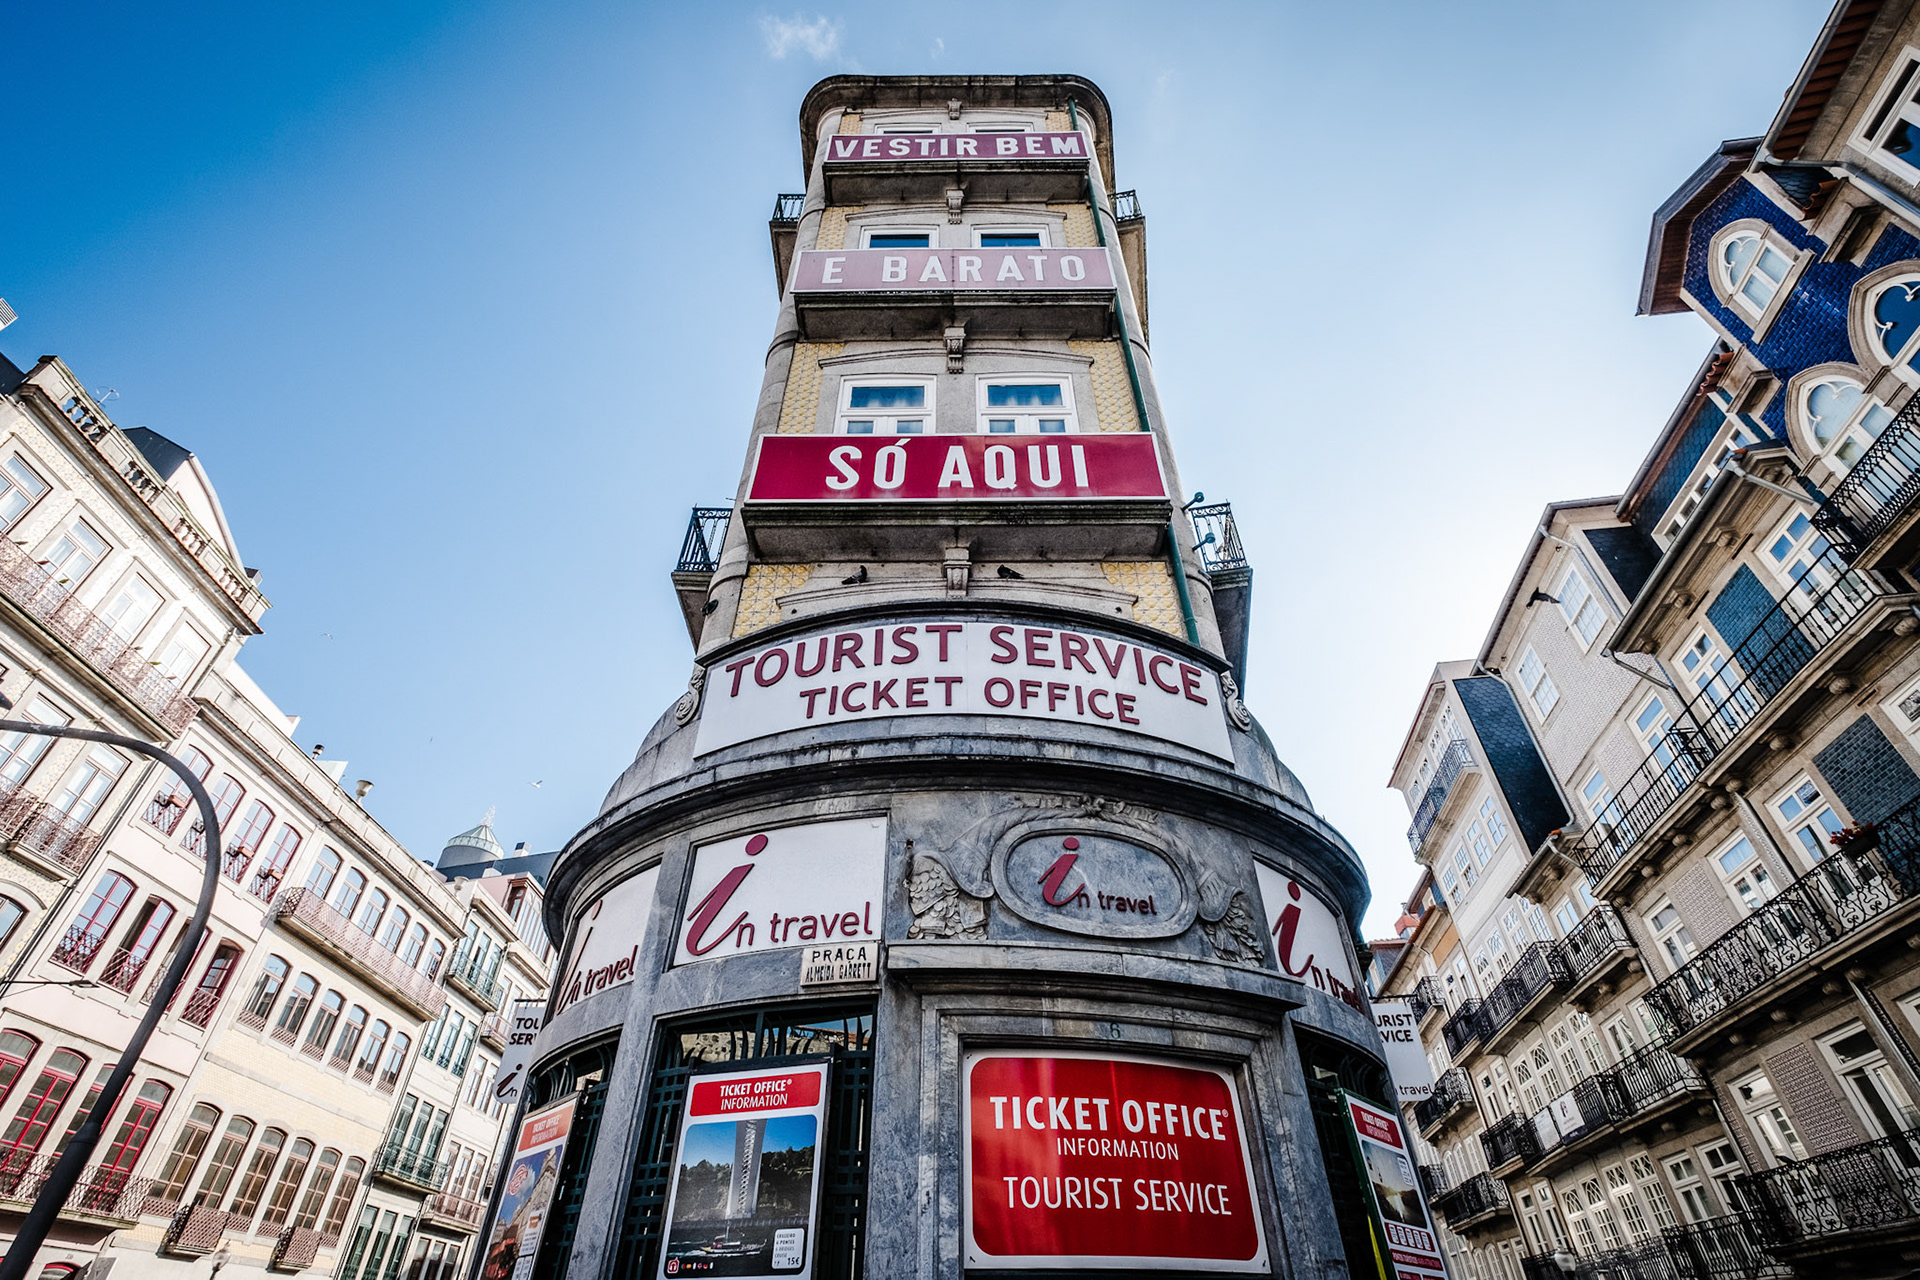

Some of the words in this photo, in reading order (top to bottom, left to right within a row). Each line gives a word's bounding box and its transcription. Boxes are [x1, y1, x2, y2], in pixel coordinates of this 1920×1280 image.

[834, 137, 978, 158] VESTIR
[997, 136, 1080, 155] BEM
[822, 257, 847, 284] E
[882, 254, 1085, 282] BARATO
[826, 439, 908, 490] SÓ
[938, 445, 1090, 490] AQUI
[726, 625, 962, 697] TOURIST
[991, 626, 1208, 705] SERVICE
[800, 676, 962, 718] TICKET
[984, 677, 1140, 724] OFFICE
[1097, 891, 1157, 915] travel
[770, 902, 873, 943] travel
[812, 946, 867, 964] PRAÇA
[583, 945, 638, 996] travel
[839, 962, 871, 980] GARRETT
[1110, 1022, 1120, 1039] 6
[720, 1083, 751, 1097] TICKET
[1399, 1083, 1433, 1096] travel
[721, 1093, 788, 1111] INFORMATION
[990, 1096, 1109, 1131] TICKET
[1057, 1137, 1179, 1160] INFORMATION
[1003, 1176, 1122, 1209] TOURIST
[1133, 1178, 1232, 1215] SERVICE
